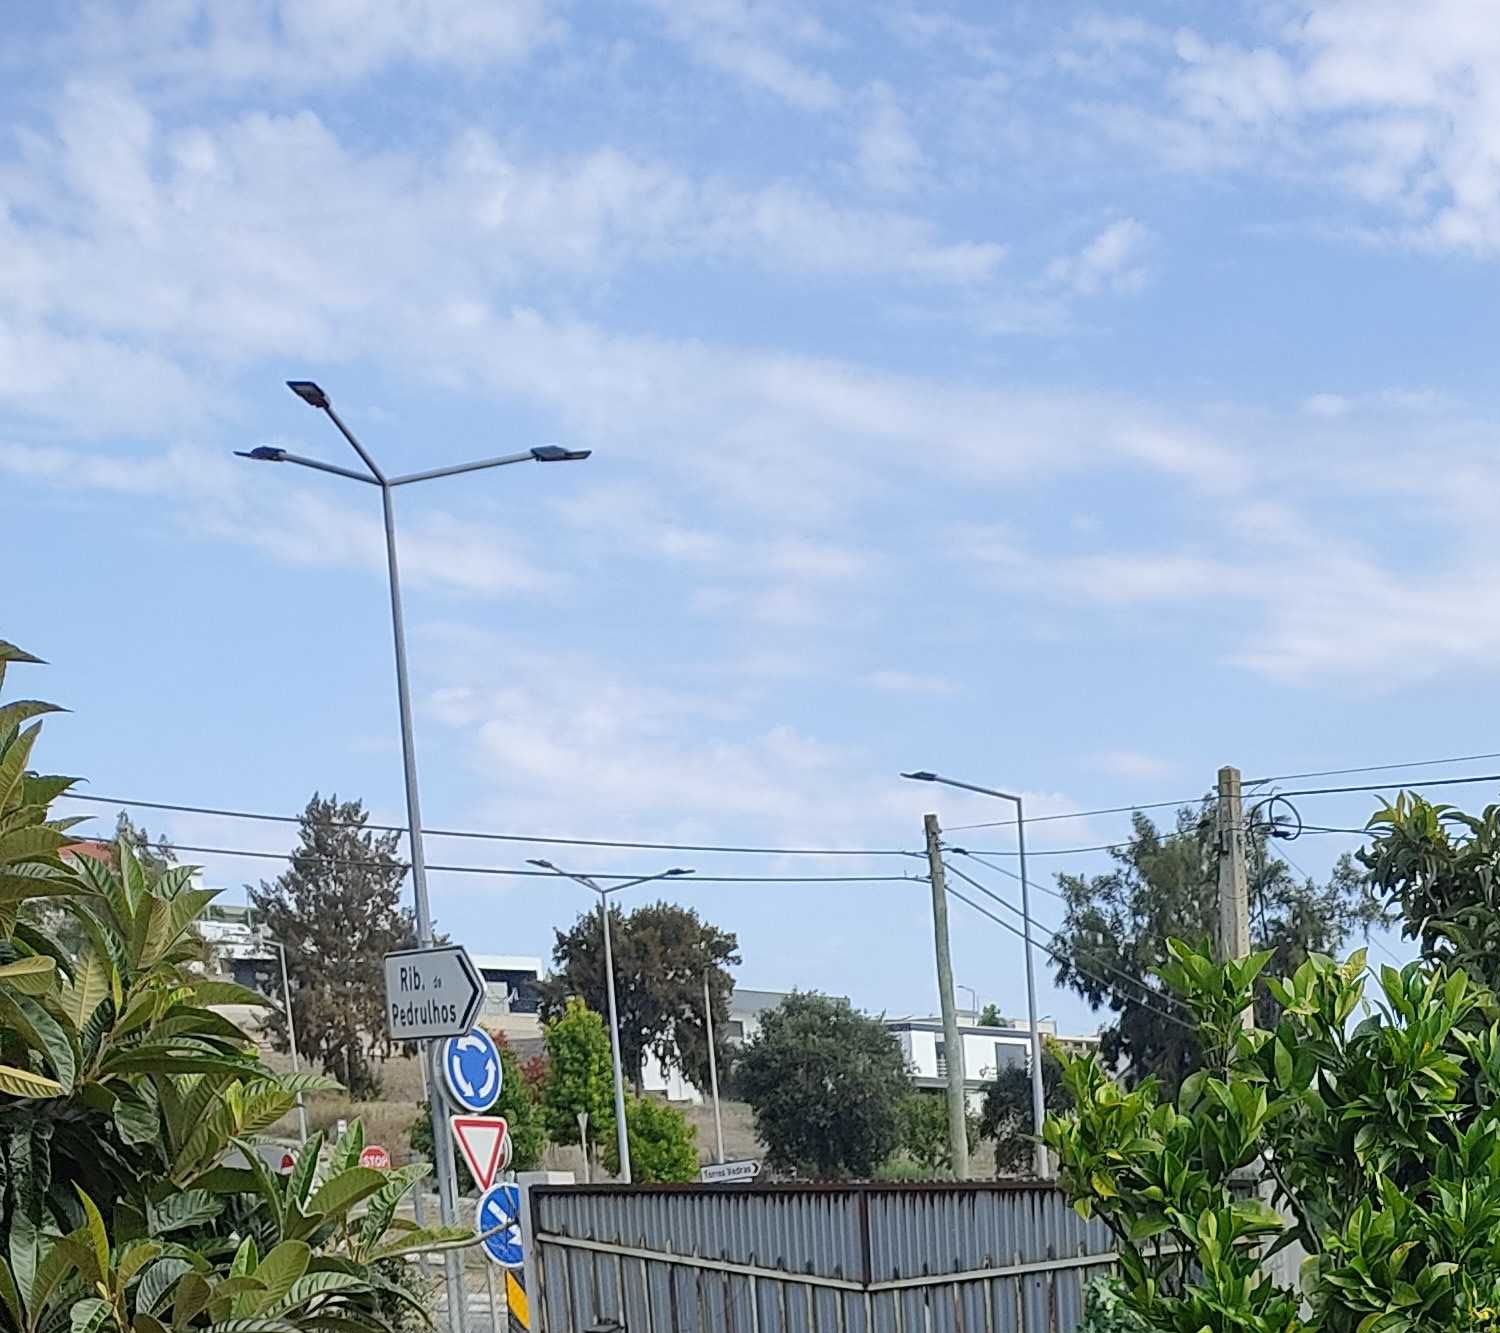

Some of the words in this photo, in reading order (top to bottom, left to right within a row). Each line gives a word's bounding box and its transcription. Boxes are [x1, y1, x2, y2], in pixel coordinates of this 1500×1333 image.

[400, 966, 425, 992] Rib.
[392, 999, 456, 1027] Pedrulhos
[363, 1155, 387, 1167] STOP
